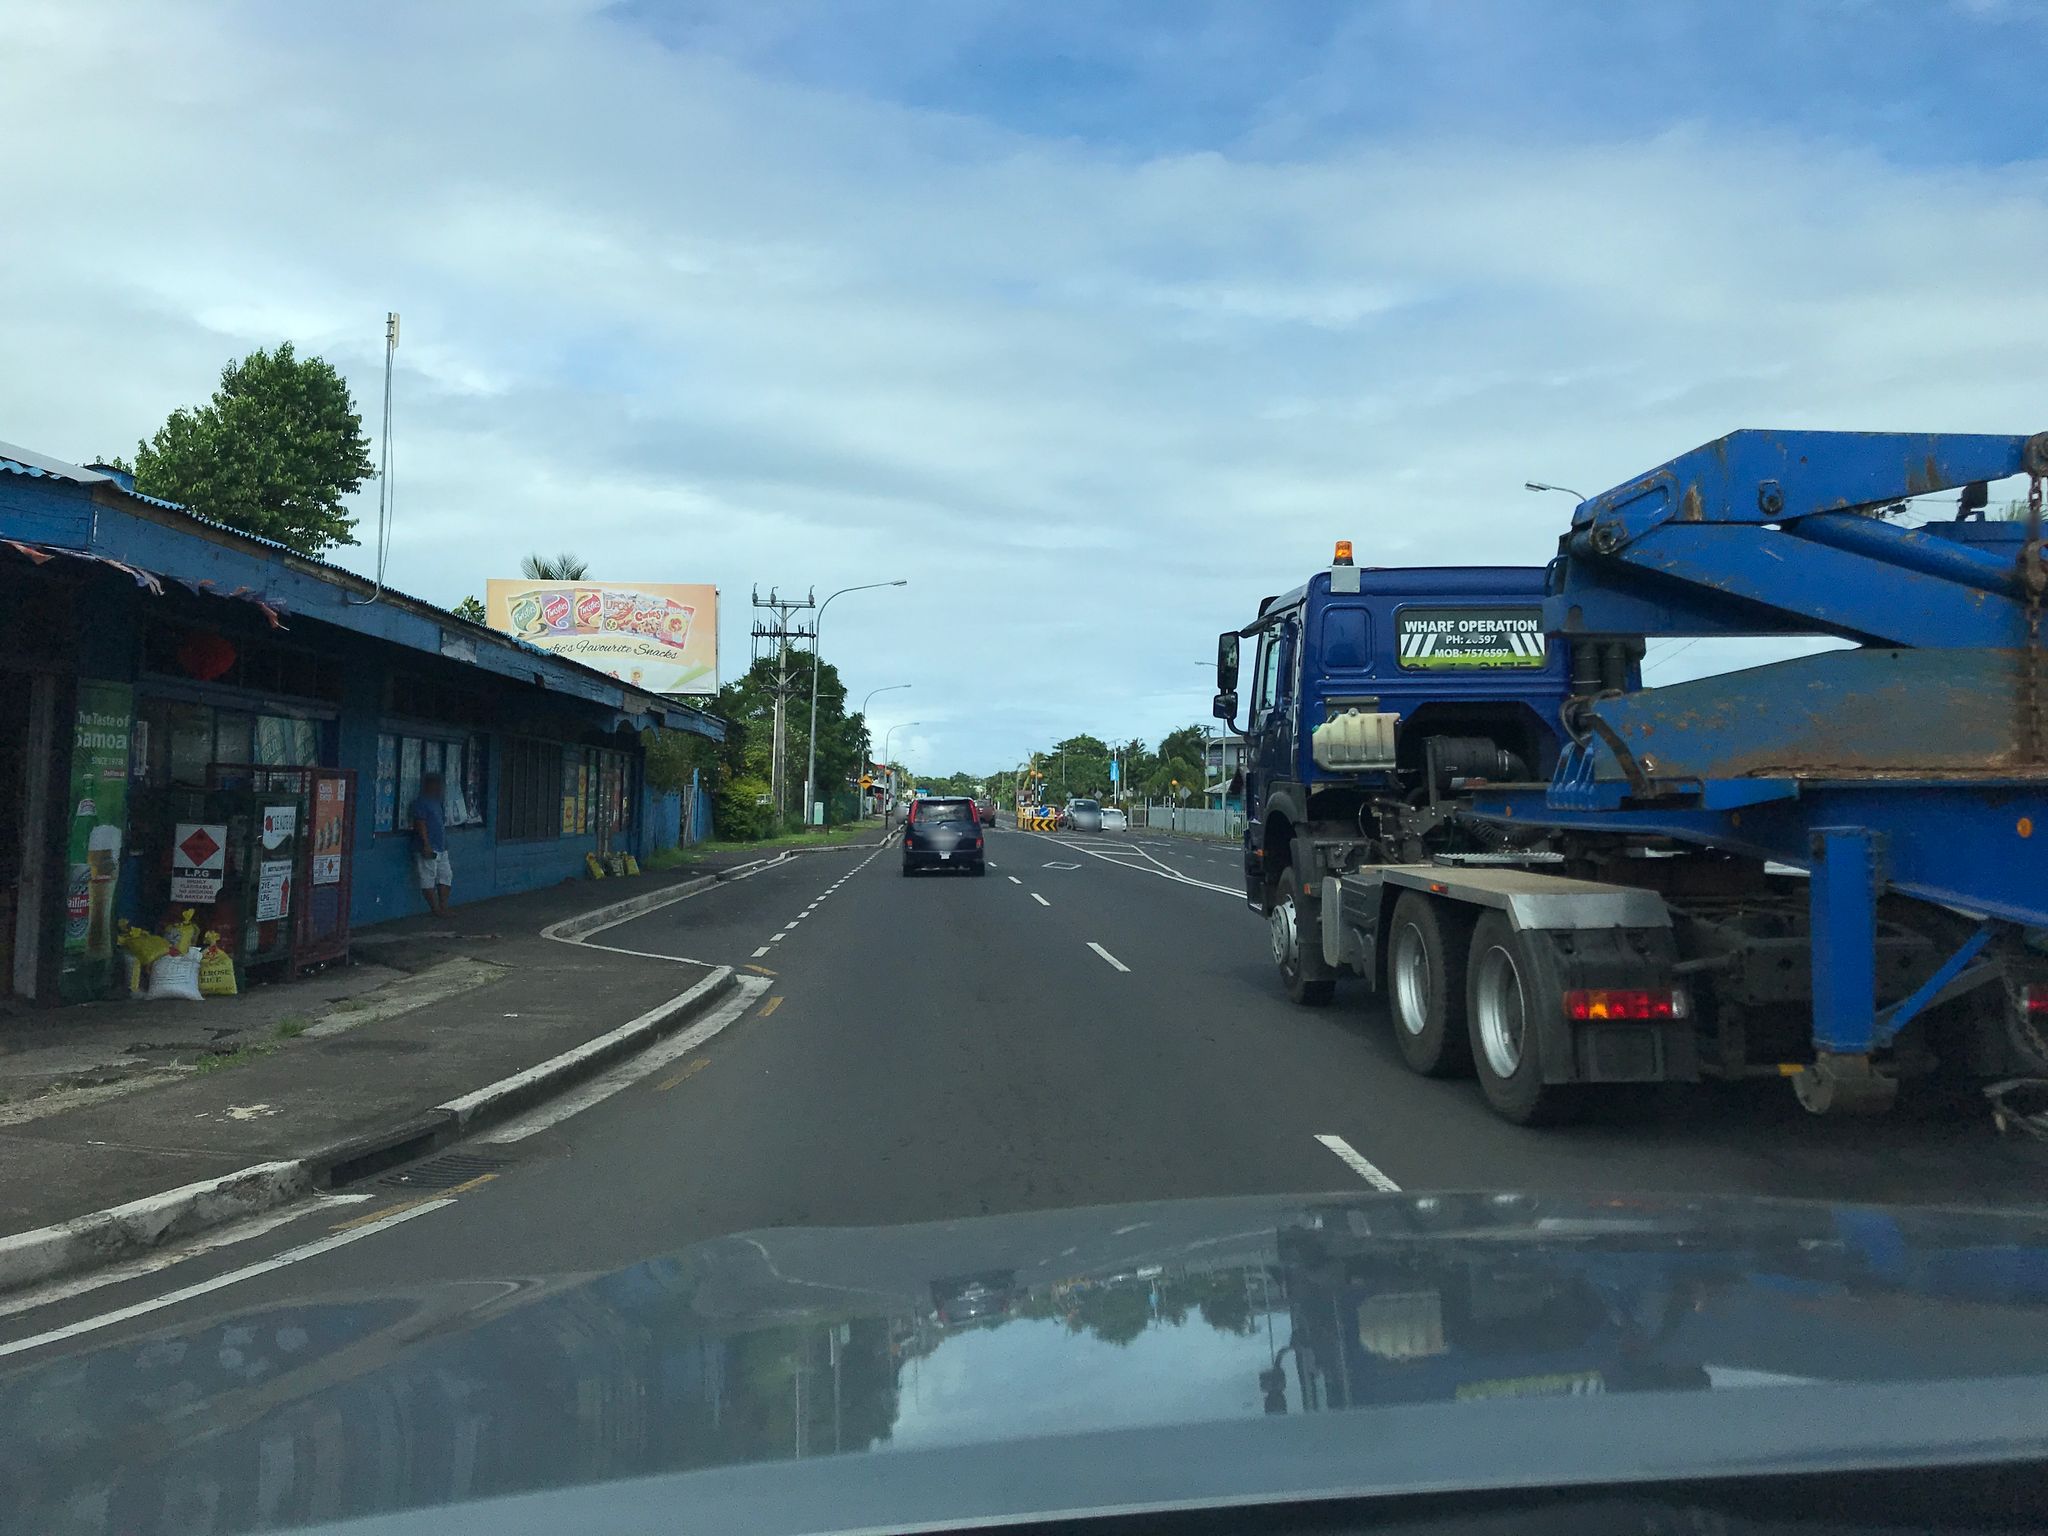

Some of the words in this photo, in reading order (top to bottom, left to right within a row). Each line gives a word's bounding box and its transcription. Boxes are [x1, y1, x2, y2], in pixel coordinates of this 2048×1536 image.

[1405, 620, 1454, 632] WHARF
[1458, 620, 1537, 632] OPERATION
[1446, 635, 1463, 644] PH:
[576, 640, 632, 653] Favourite
[634, 643, 678, 659] Snacks
[1434, 649, 1462, 658] MOB:
[1465, 648, 1509, 657] 7576597
[92, 712, 116, 726] Taste
[116, 714, 131, 727] of
[184, 869, 209, 877] L.P.G
